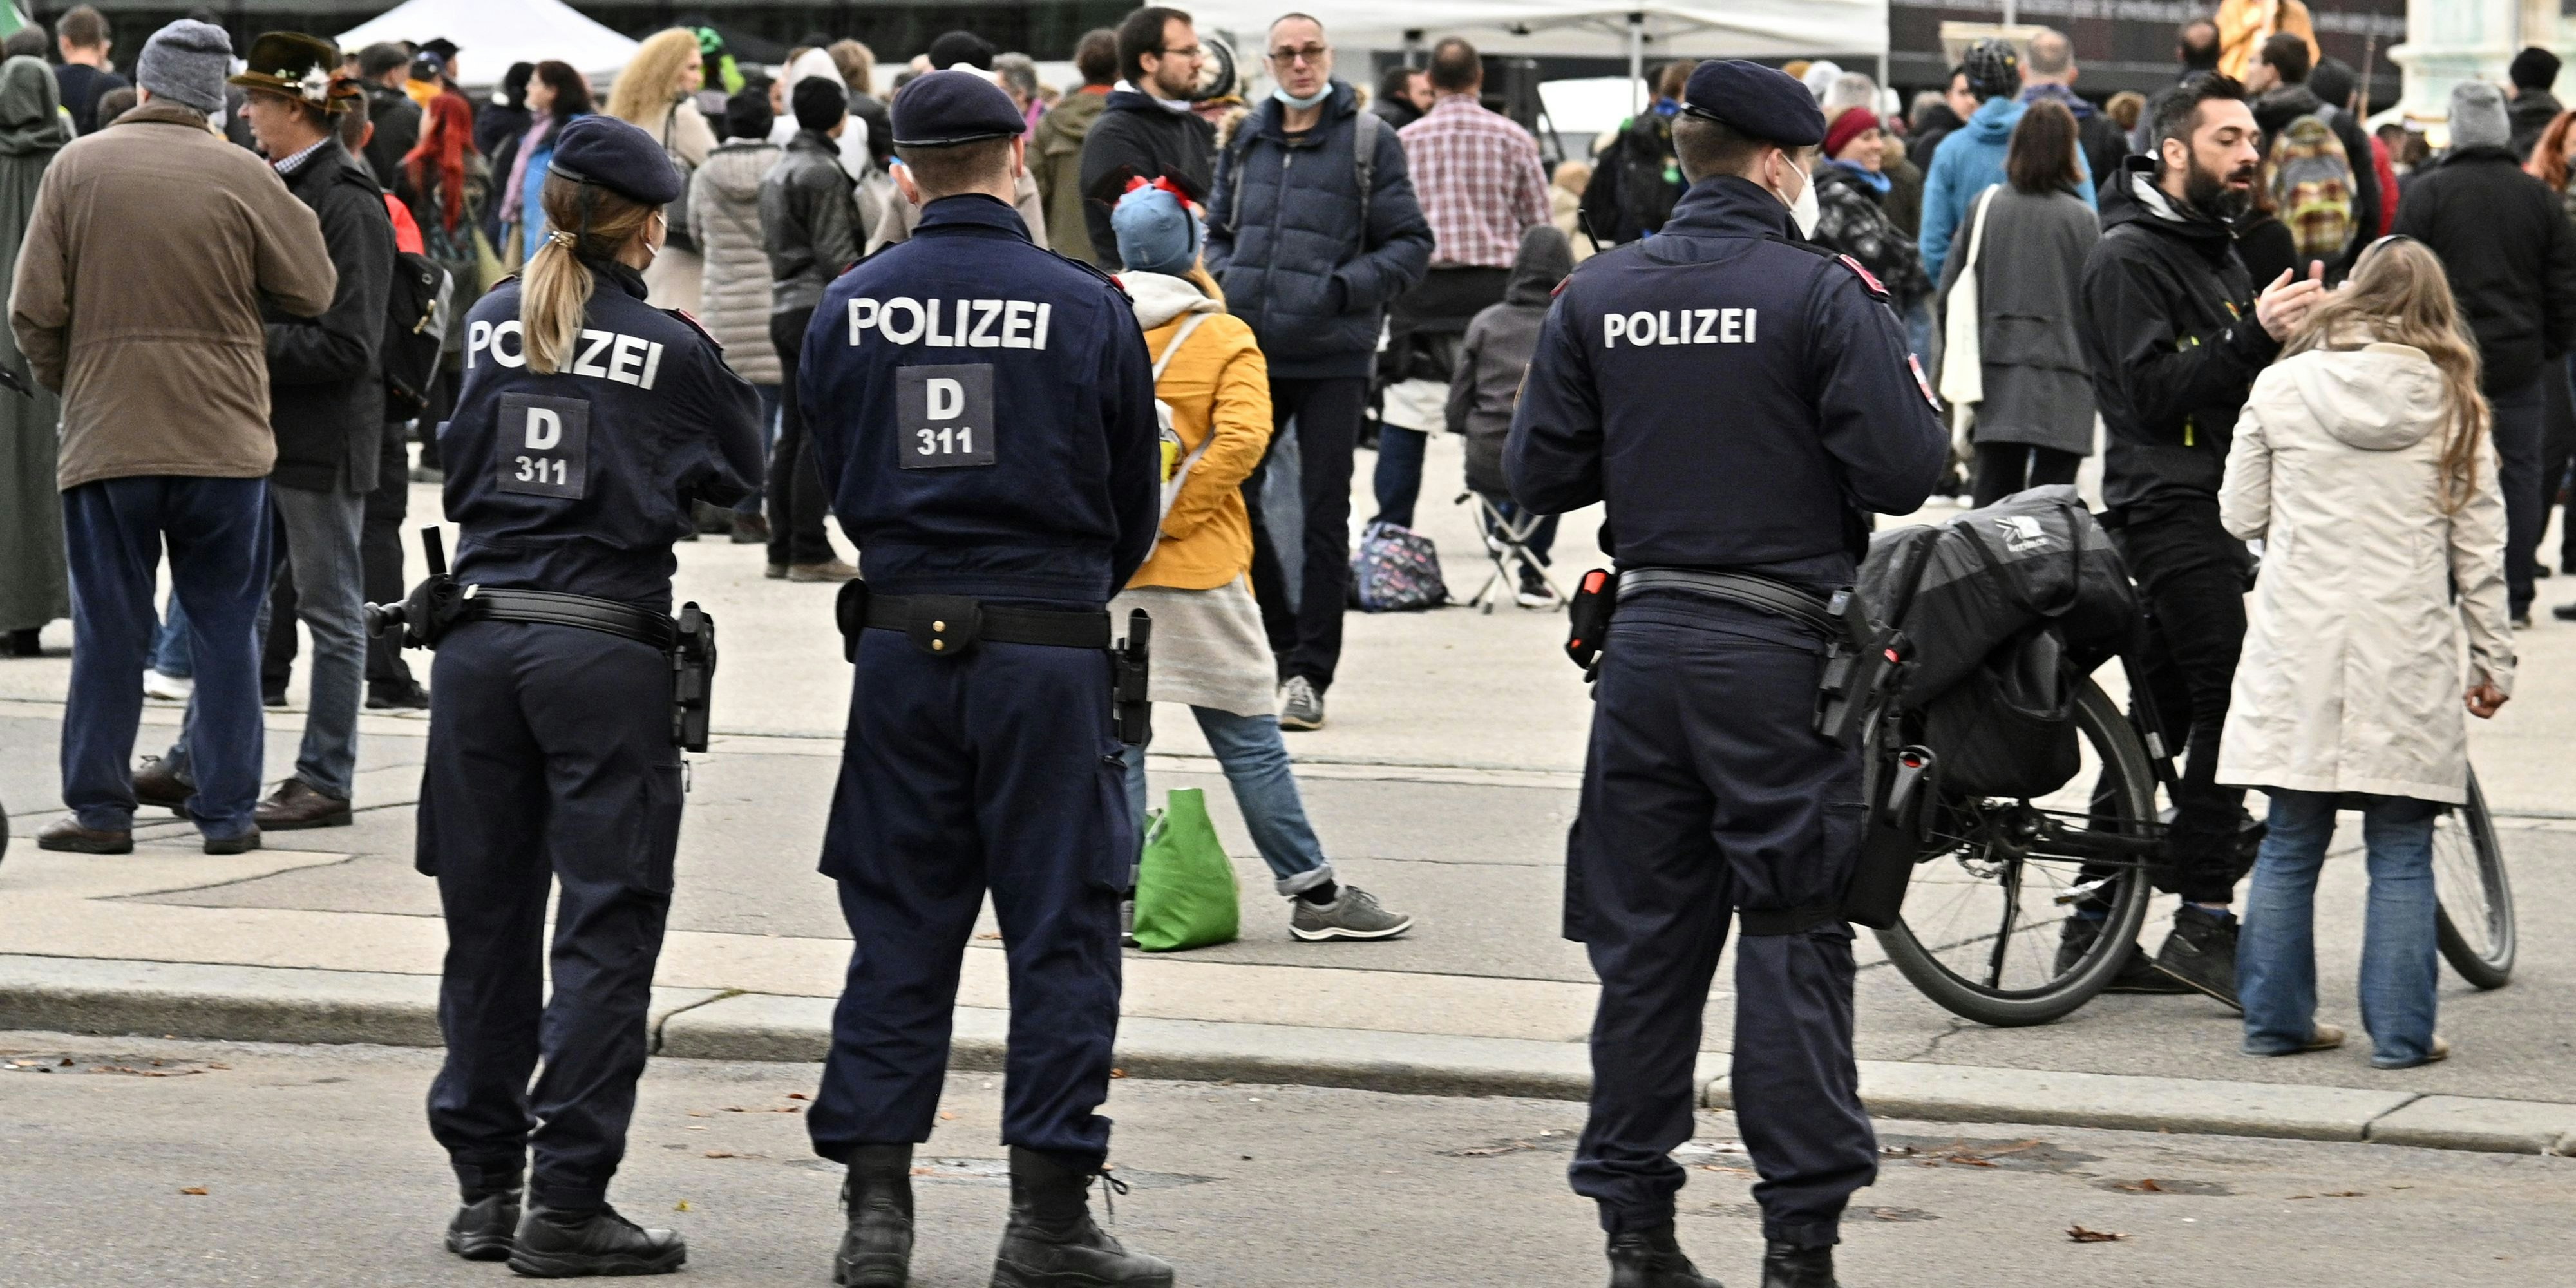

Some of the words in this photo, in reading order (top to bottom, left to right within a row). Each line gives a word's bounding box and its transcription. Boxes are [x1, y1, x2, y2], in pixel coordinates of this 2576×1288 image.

[848, 297, 1052, 350] POLIZEI
[1604, 308, 1757, 348] POLIZEI
[468, 320, 664, 390] POIZEI
[926, 378, 965, 420] D
[525, 407, 562, 450] D
[916, 426, 972, 455] 311
[515, 455, 567, 485] 311
